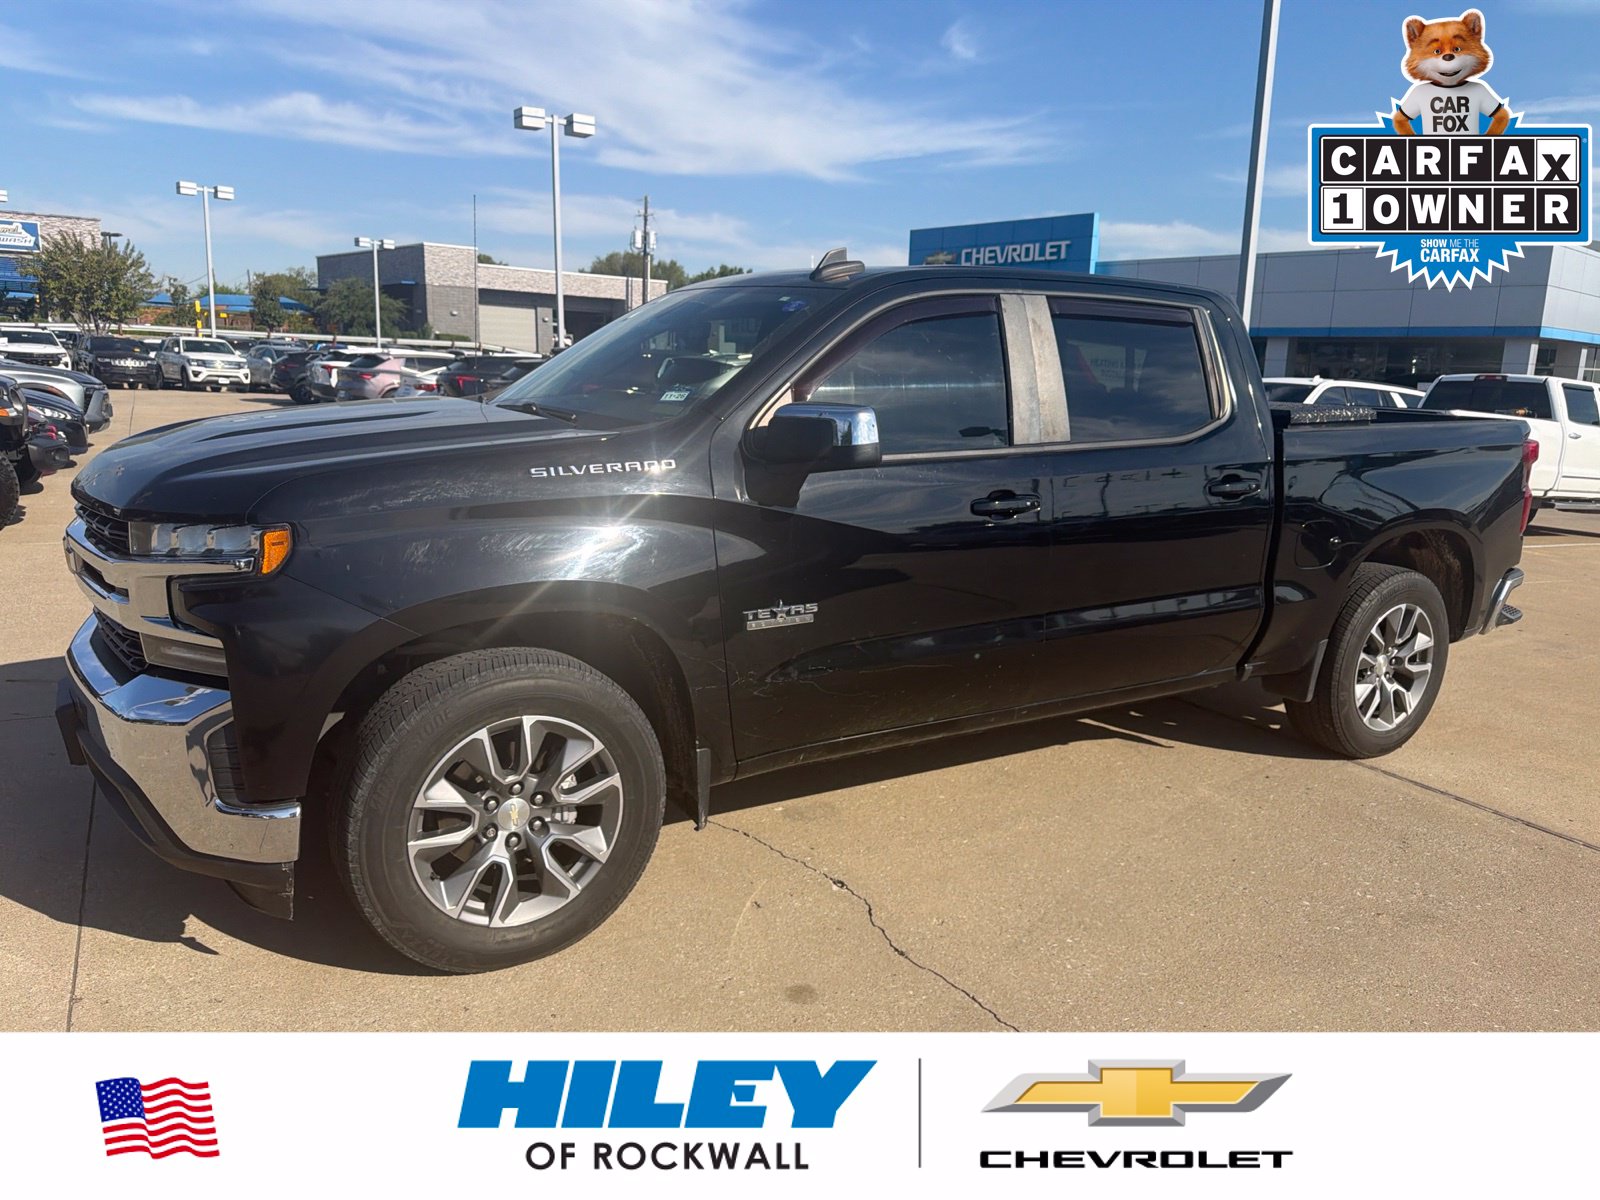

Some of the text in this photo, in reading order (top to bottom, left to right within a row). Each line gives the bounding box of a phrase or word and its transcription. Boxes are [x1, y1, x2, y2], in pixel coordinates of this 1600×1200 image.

[961, 240, 1071, 266] CHEVROLET
[530, 459, 677, 478] SILVERADO
[742, 600, 819, 621] TEXAS
